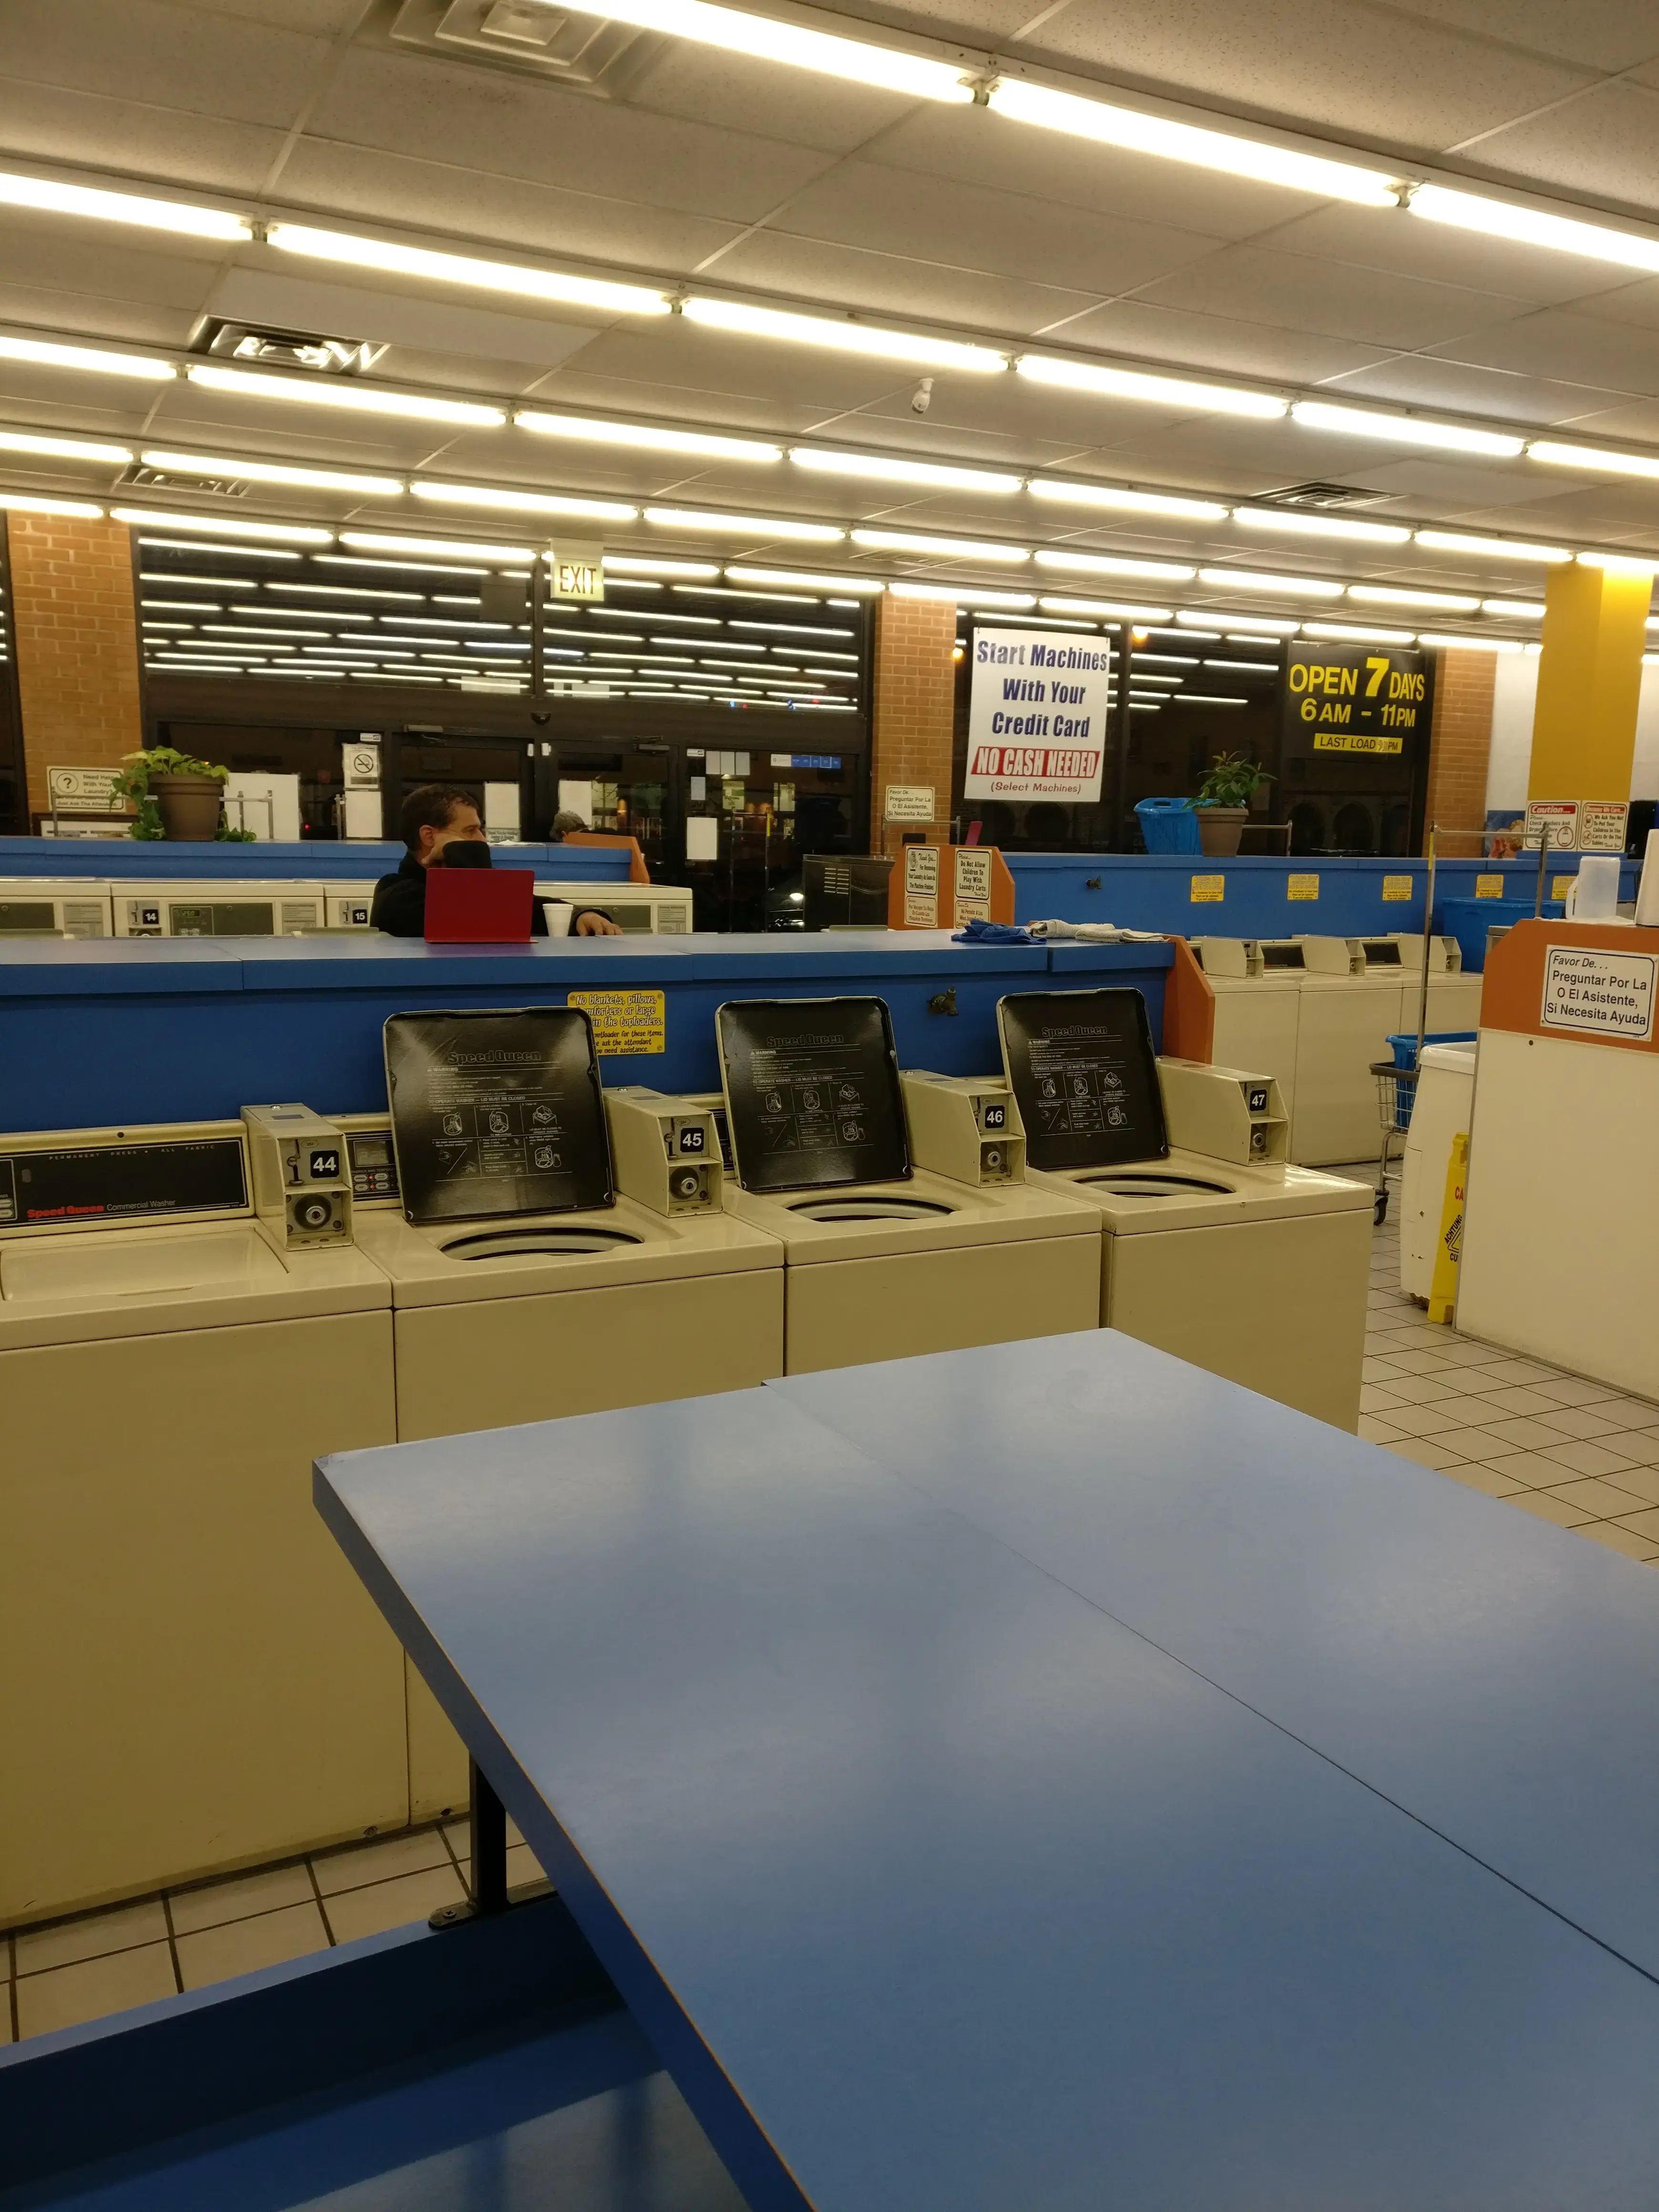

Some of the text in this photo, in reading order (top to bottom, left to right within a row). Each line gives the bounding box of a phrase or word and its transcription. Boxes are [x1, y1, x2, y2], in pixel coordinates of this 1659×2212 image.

[560, 565, 596, 594] EXIT
[977, 641, 1107, 671] Start Machines
[1290, 657, 1424, 701] OPEN 7 DAYS
[1003, 678, 1086, 704] With Your
[992, 712, 1090, 737] Credit Card
[1320, 737, 1347, 747] LAST
[1351, 738, 1376, 749] LOAD
[976, 747, 1096, 778] NO CASH NEEDED
[991, 782, 1081, 794] (Select Machines)
[144, 912, 157, 922] 14
[355, 912, 366, 921] 15
[1553, 955, 1580, 966] Favor
[1553, 970, 1647, 990] Preguntar Por La
[576, 993, 657, 1005] No blankets, pillows,
[1557, 987, 1638, 1009] O El Asistente,
[625, 1007, 634, 1015] or
[635, 1004, 655, 1016] large
[1547, 1003, 1646, 1025] Si Necesita Ayuda
[604, 1016, 617, 1028] the
[620, 1016, 663, 1028] toploaders.
[1042, 1025, 1108, 1038] Speed Queen
[767, 1034, 843, 1047] Speed Queen
[448, 1050, 542, 1065] Speed Queen
[1251, 1094, 1265, 1106] 47
[987, 1110, 1003, 1123] 46
[682, 1133, 702, 1147] 45
[313, 1157, 337, 1172] 44
[27, 1199, 176, 1219] Speed Queen Commercial Washer
